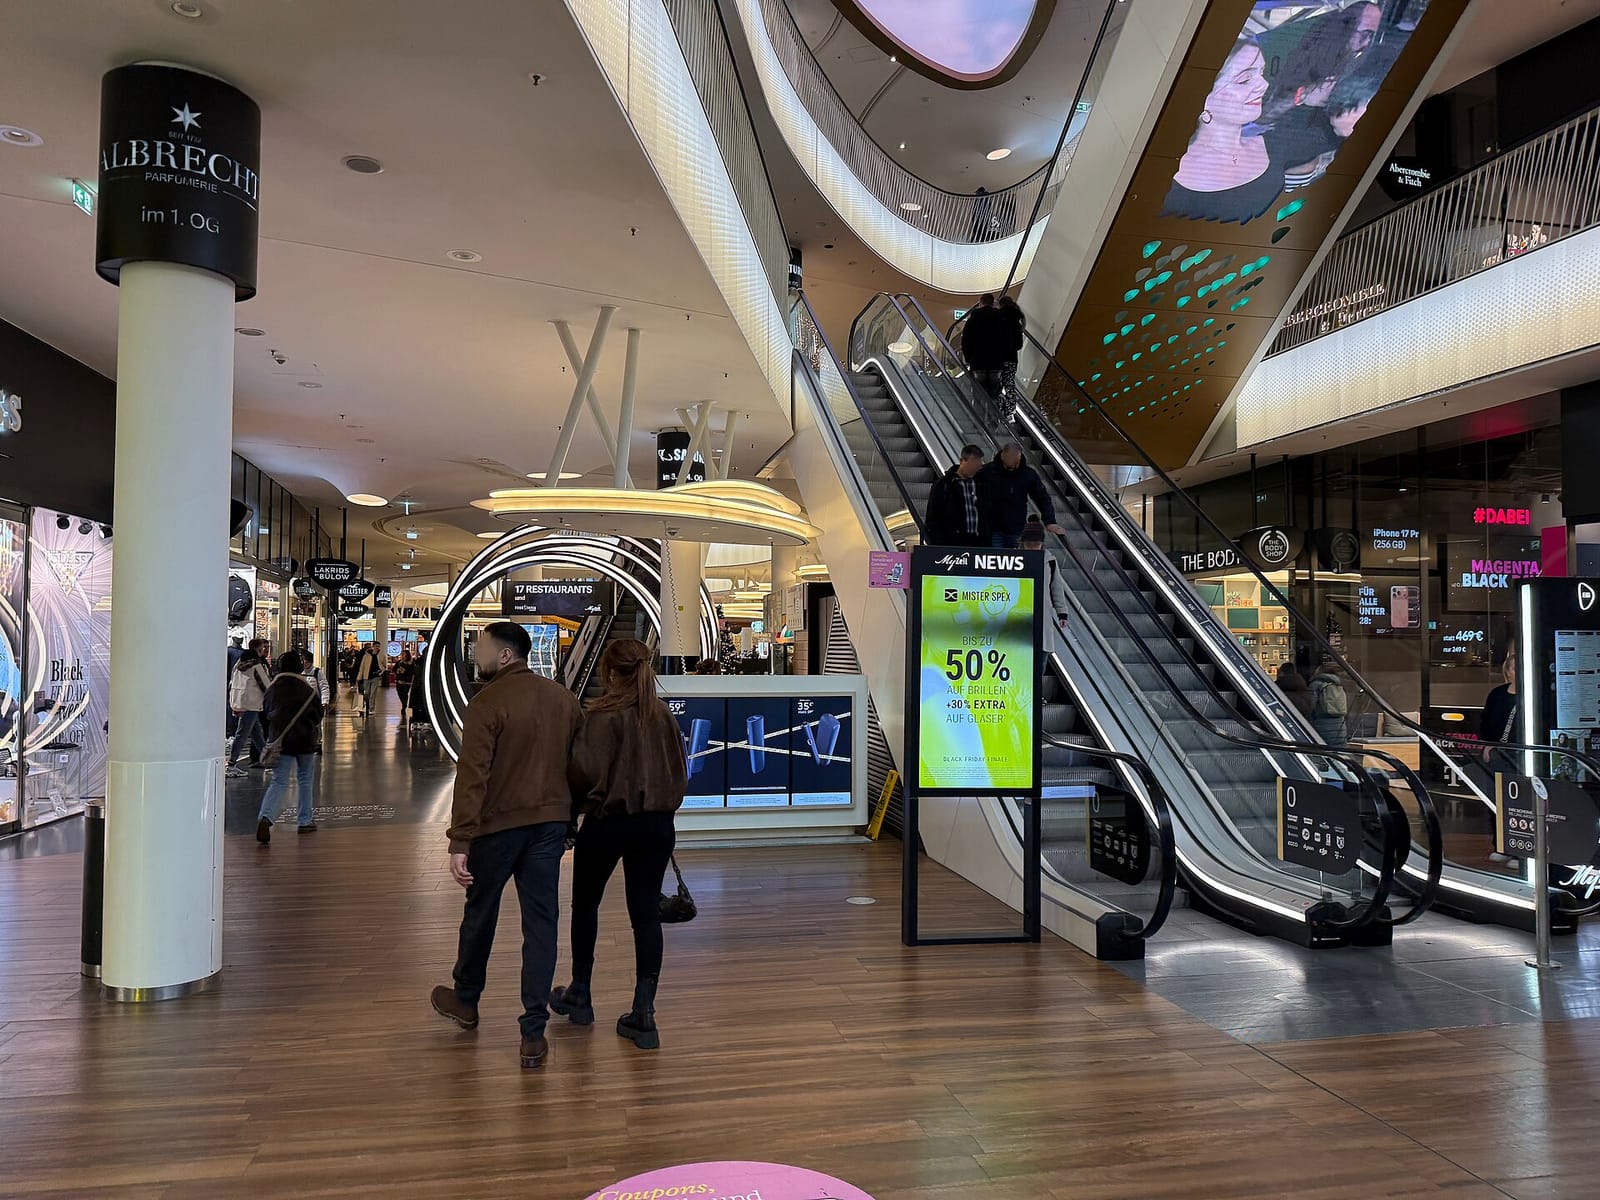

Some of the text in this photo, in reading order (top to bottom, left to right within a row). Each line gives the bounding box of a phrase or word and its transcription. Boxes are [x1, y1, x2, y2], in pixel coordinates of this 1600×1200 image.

[1389, 162, 1431, 179] Abercrombie
[145, 171, 218, 193] PARFÜMERIE
[1404, 175, 1422, 187] Fitch
[141, 205, 220, 234] im 1. OG
[1473, 507, 1530, 526] #DABEI
[1373, 528, 1400, 538] iPhone
[1400, 529, 1409, 538] 17
[1373, 540, 1406, 551] (256 GB)
[974, 554, 1025, 571] NEWS
[1181, 553, 1205, 572] THE
[1471, 559, 1541, 575] MAGENTA
[314, 566, 350, 574] LAKRIDS
[319, 573, 350, 581] BÜLOW
[1462, 573, 1509, 588] BLACK
[514, 585, 593, 594] 17 RESTAURANTS
[1359, 586, 1375, 596] FÜR
[962, 591, 1011, 602] MISTER SPEX
[1359, 598, 1378, 606] ALLE
[1359, 607, 1386, 616] UNTER
[962, 636, 993, 646] BIS ZU
[50, 658, 84, 682] Black
[945, 649, 1011, 682] 50%
[946, 686, 1006, 696] AUF BRILLEN
[797, 701, 814, 711] 35€
[973, 699, 1006, 710] EXTRA
[946, 714, 964, 724] AUF
[1508, 781, 1519, 800] 0
[1286, 786, 1296, 808] 0
[1558, 864, 1600, 900] My
[598, 1183, 715, 1200] Coupons,
